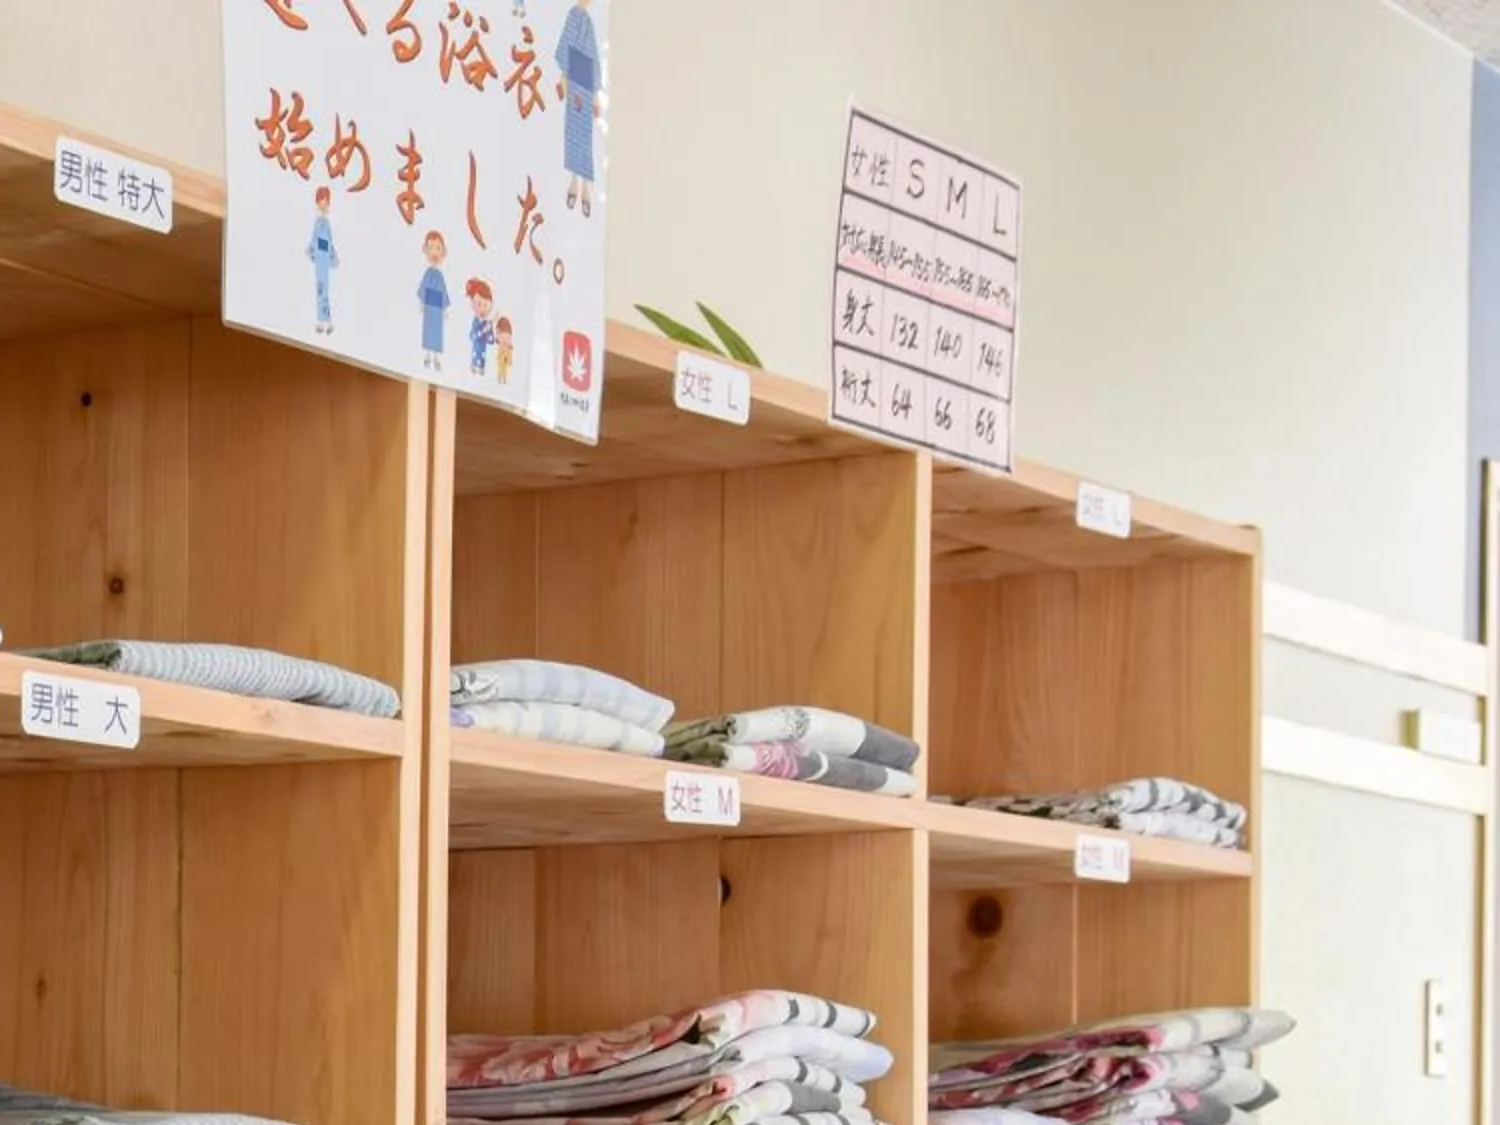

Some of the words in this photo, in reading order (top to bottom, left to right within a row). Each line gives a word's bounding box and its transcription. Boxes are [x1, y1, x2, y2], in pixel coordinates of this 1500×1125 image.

[60, 150, 108, 201] 男性
[117, 167, 165, 220] 特大
[255, 88, 565, 285] 始めました。
[851, 146, 890, 188] 女性
[906, 158, 925, 199] S
[947, 177, 967, 220] M
[993, 193, 1007, 236] L
[891, 313, 918, 349] 132
[934, 326, 962, 359] 140
[891, 384, 912, 423] 64
[935, 397, 953, 431] 66
[975, 407, 995, 444] 68
[31, 683, 79, 728] 男性
[104, 695, 128, 735] 大
[717, 785, 733, 817] M
